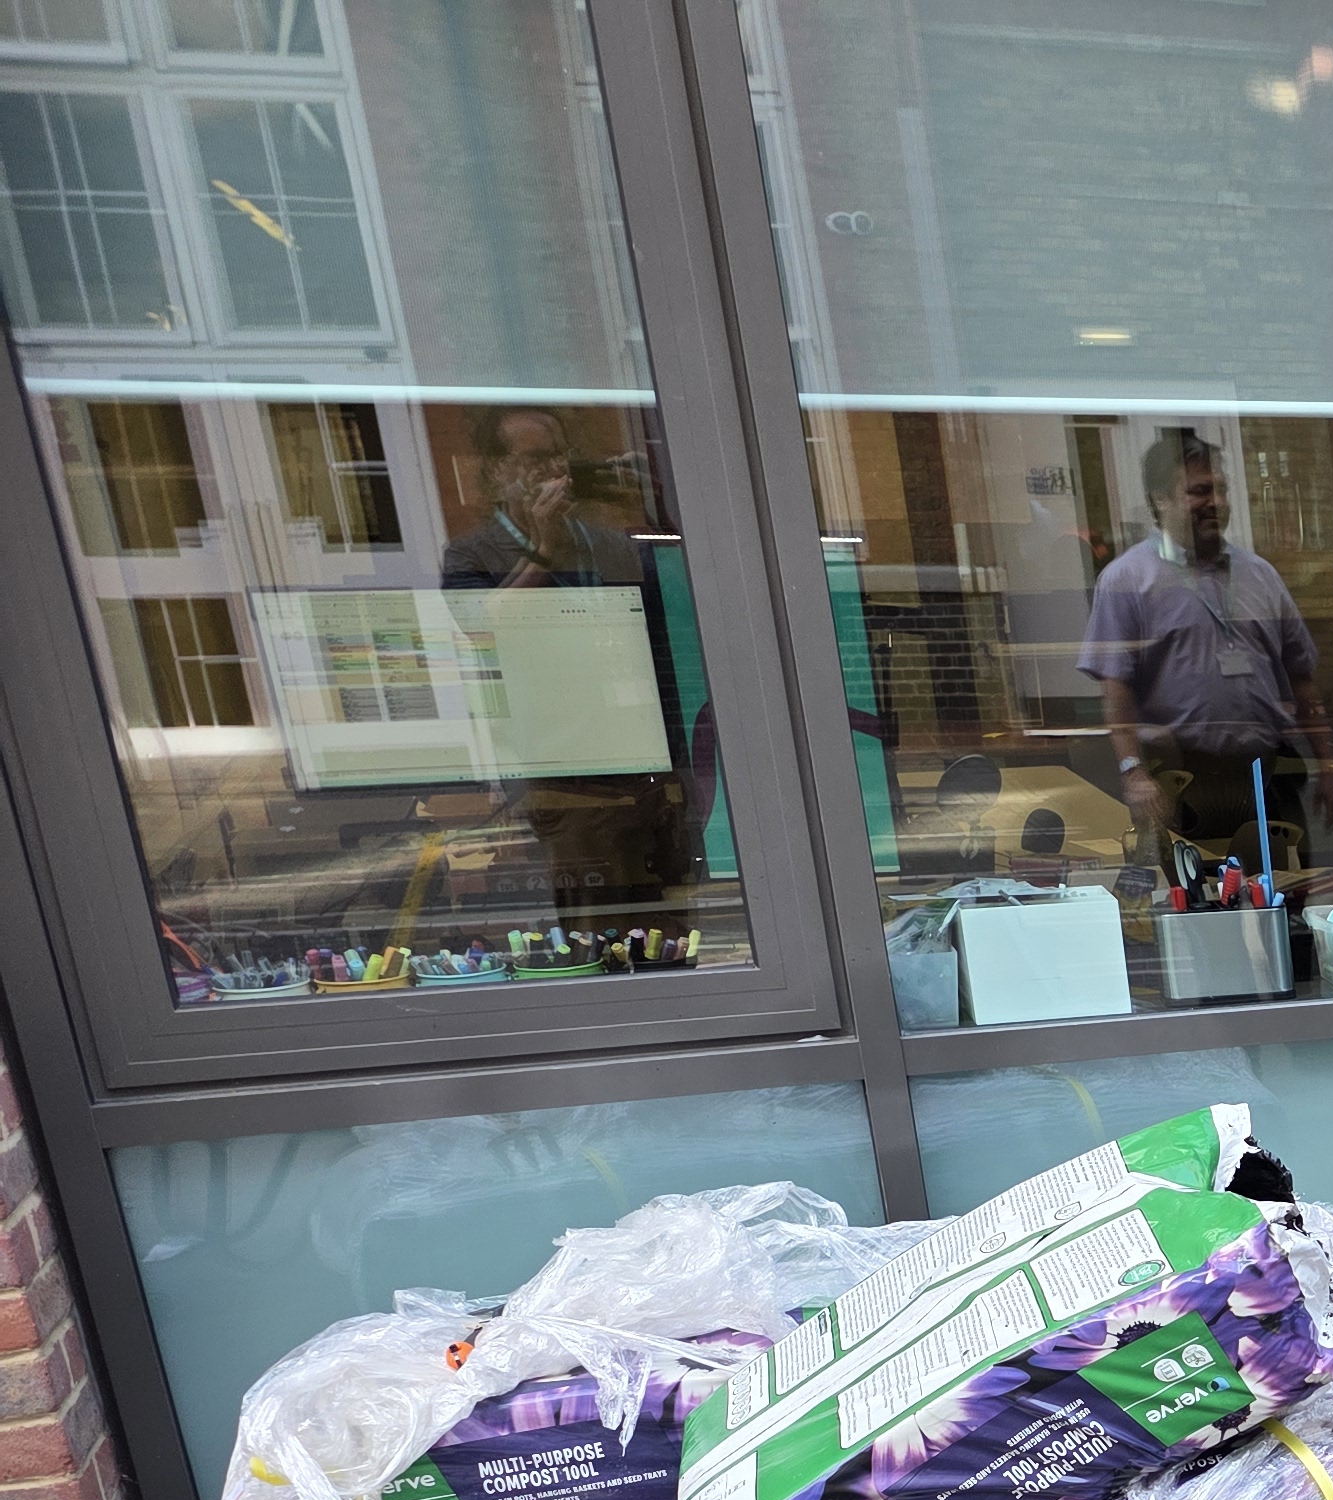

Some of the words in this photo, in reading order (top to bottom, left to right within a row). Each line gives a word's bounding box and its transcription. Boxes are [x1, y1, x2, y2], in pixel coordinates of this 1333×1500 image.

[1146, 1389, 1209, 1424] verve
[478, 1442, 605, 1479] MULTI-PURPOSE
[1036, 1420, 1104, 1470] COMPOST
[381, 1474, 436, 1494] erve
[482, 1467, 560, 1495] COMPOST
[562, 1460, 599, 1483] 100L
[537, 1486, 572, 1500] HANGING
[572, 1480, 606, 1493] BASKETS
[606, 1477, 623, 1488] AND
[623, 1474, 642, 1485] SEED
[642, 1469, 668, 1481] TRAYS
[1002, 1456, 1042, 1486] 100L
